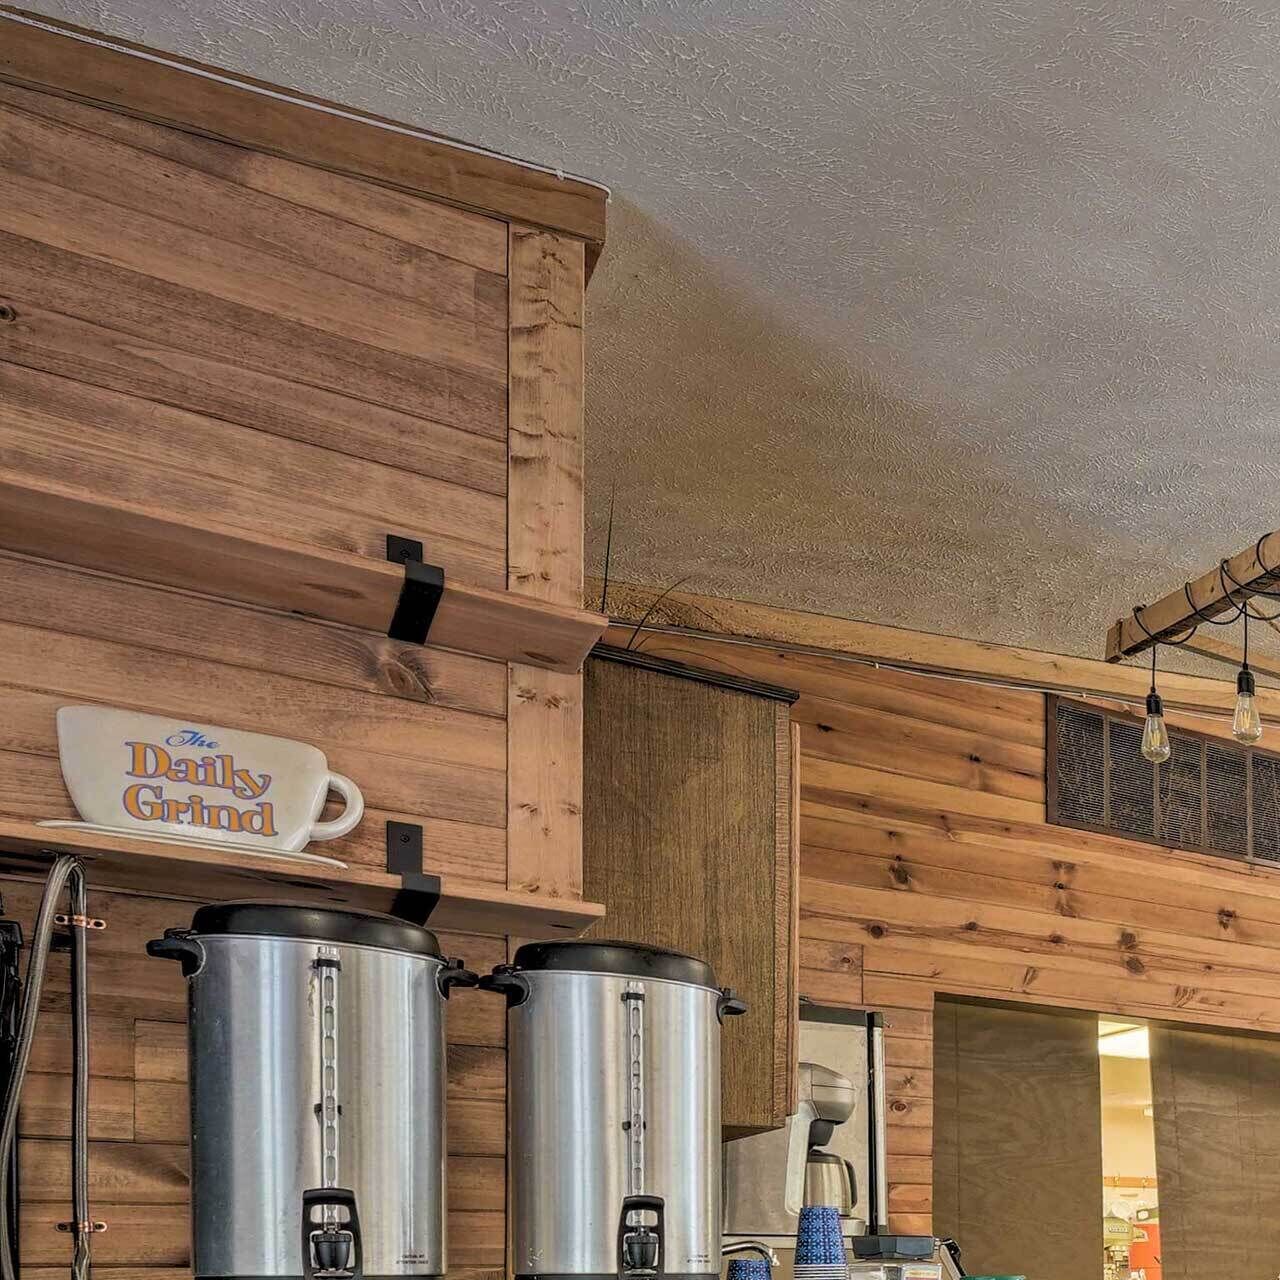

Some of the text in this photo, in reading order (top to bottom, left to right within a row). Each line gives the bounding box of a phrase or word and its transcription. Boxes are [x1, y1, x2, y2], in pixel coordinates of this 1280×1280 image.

[165, 729, 220, 749] The
[125, 741, 272, 800] Daily
[123, 783, 279, 837] Grind
